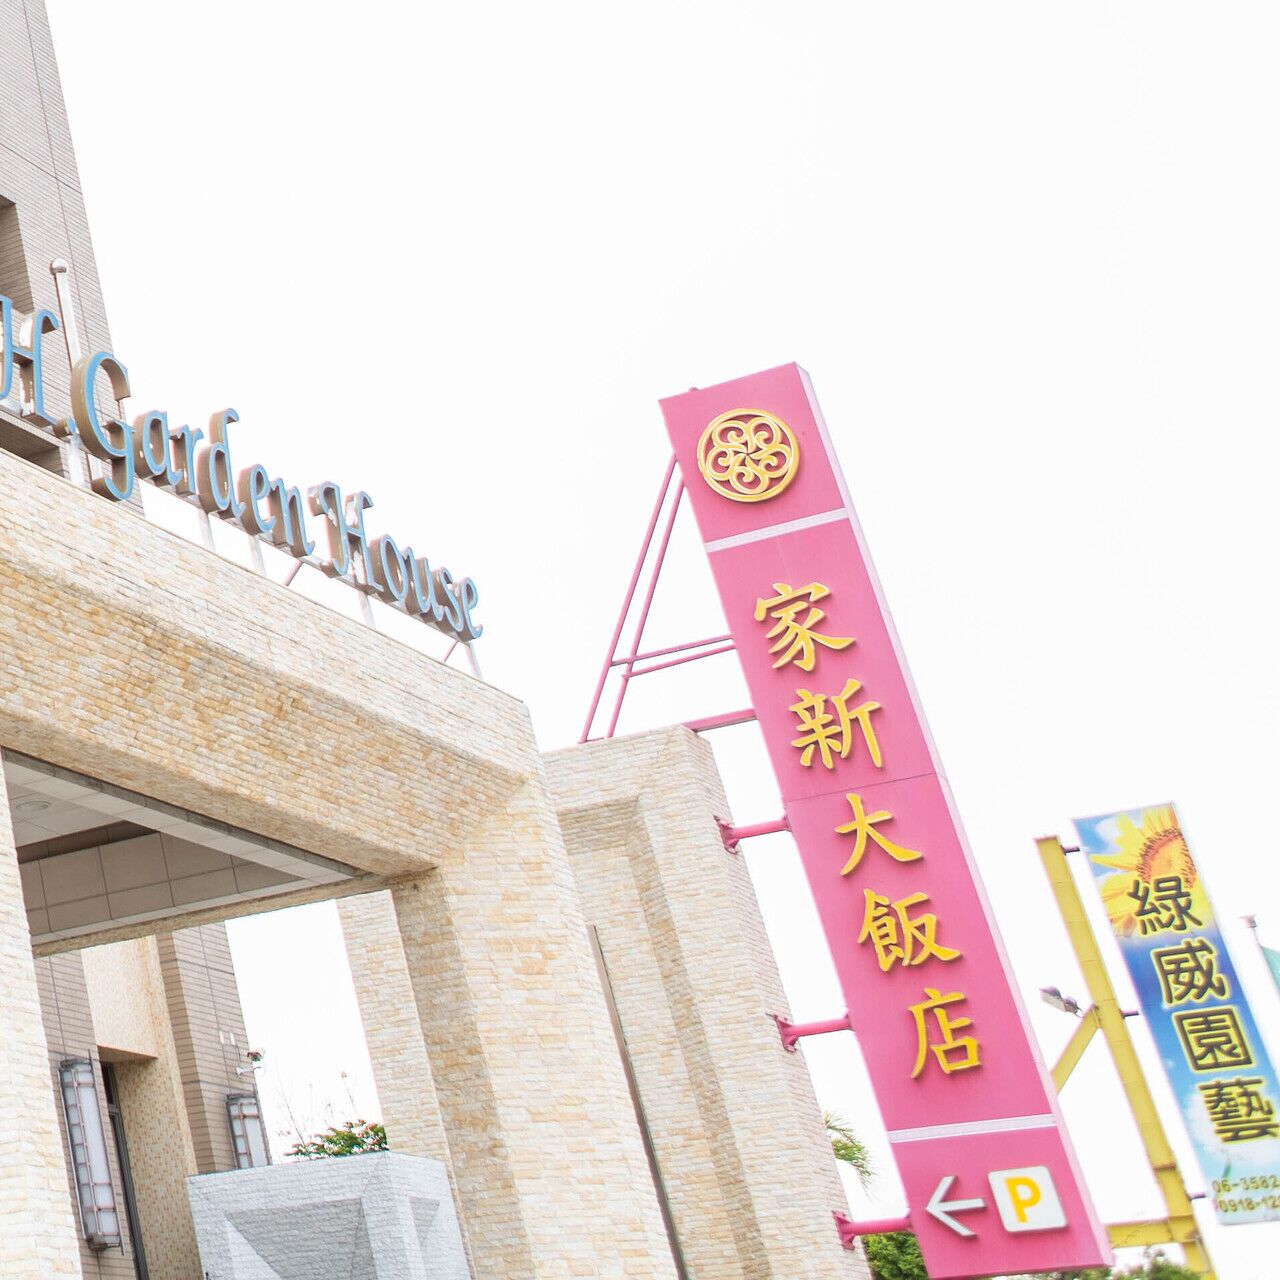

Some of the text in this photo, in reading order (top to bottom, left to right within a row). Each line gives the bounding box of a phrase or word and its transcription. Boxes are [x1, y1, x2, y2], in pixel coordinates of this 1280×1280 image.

[71, 351, 315, 558] Garden
[308, 480, 483, 642] House
[753, 581, 983, 1080] 家新大飯店
[1127, 873, 1280, 1144] 綠威園藝
[1004, 1176, 1042, 1223] P
